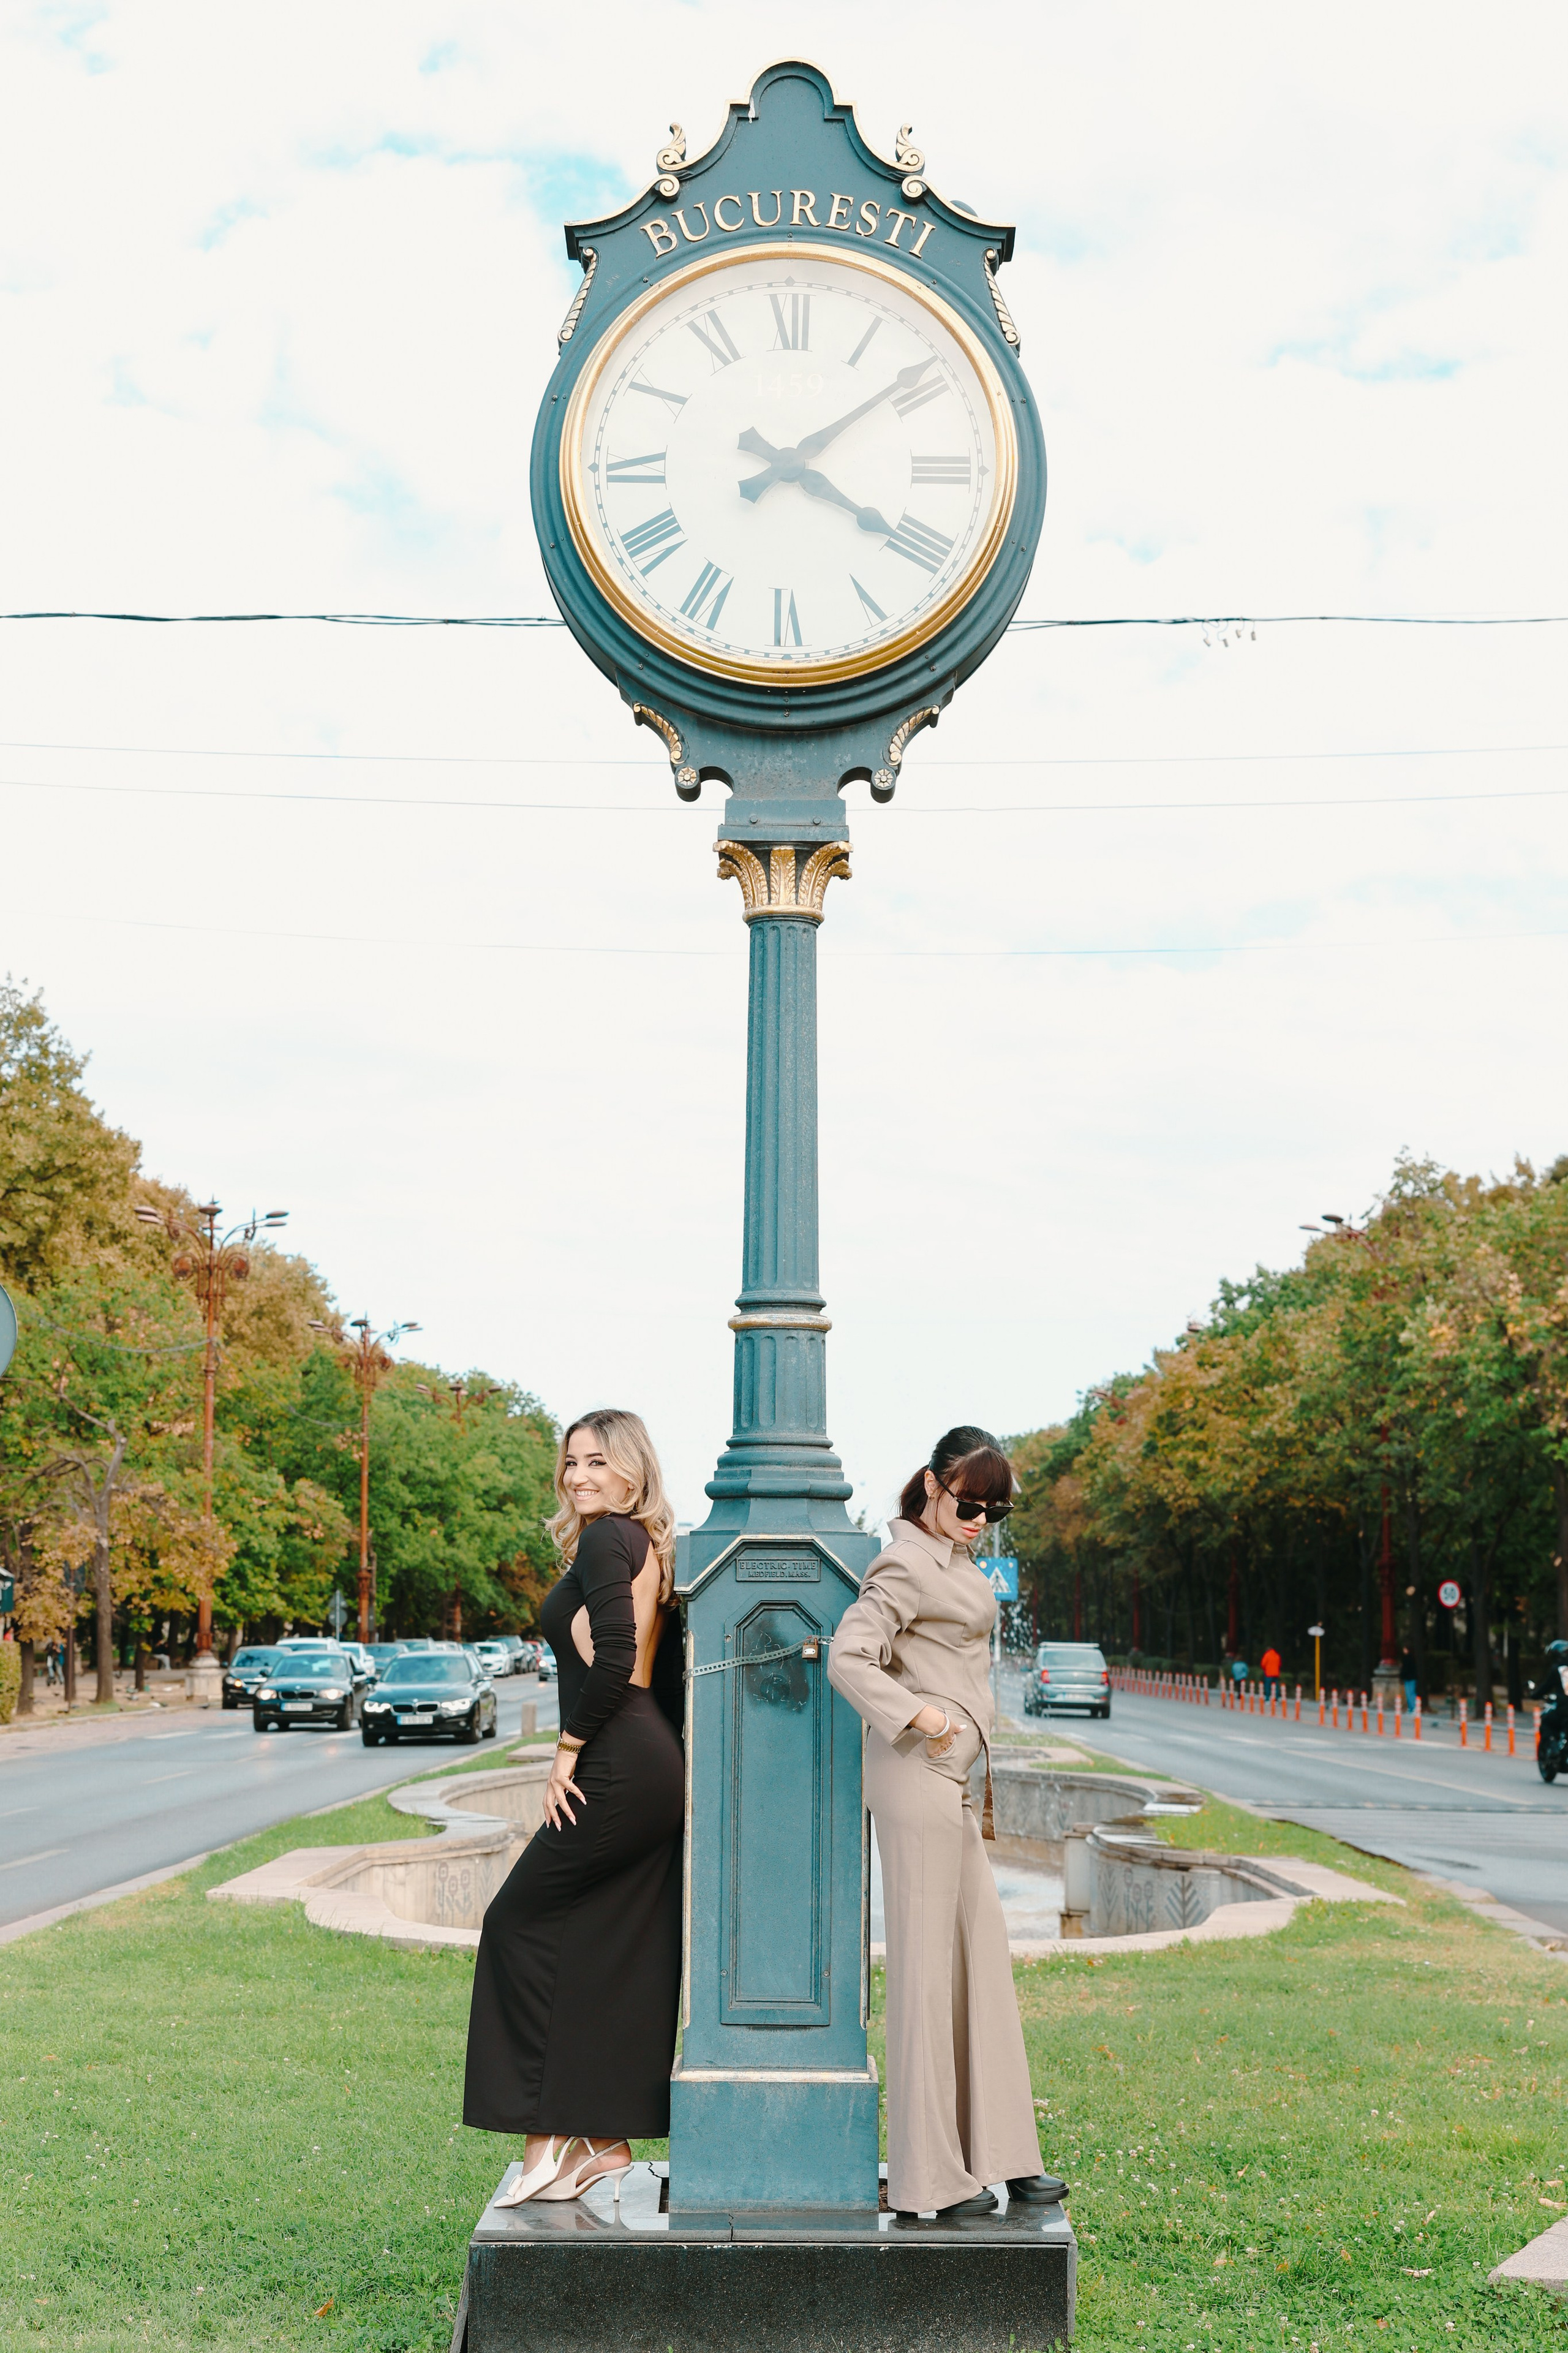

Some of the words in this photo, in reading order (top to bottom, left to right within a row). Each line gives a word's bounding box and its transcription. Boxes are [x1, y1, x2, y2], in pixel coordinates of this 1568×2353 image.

[680, 306, 747, 377] XI
[763, 293, 816, 353] XII
[841, 311, 890, 371] I
[623, 363, 693, 424] X
[752, 372, 824, 399] 1459
[888, 368, 954, 424] II
[606, 445, 668, 491] IX
[910, 447, 972, 494] III
[616, 502, 688, 583] VIII
[674, 557, 734, 635] VII
[764, 587, 812, 648] VI
[849, 573, 895, 631] V
